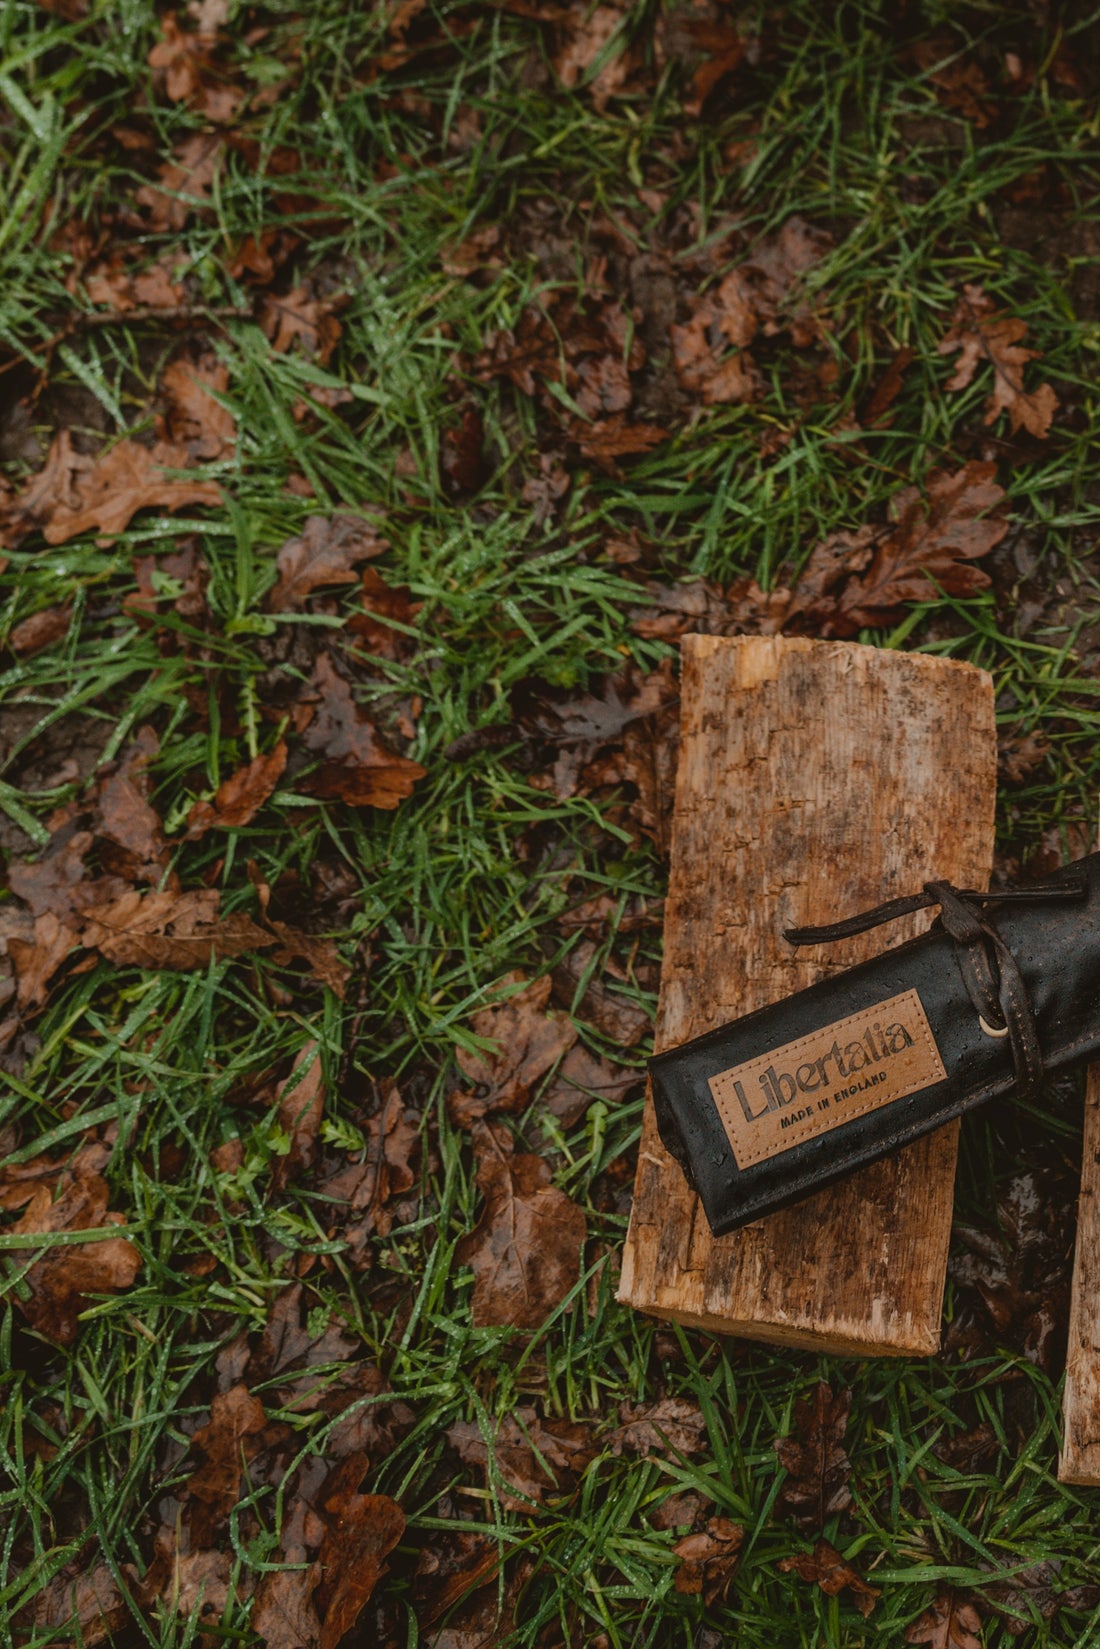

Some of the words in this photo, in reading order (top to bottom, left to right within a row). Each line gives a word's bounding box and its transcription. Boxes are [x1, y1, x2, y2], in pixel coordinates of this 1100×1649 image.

[733, 1023, 915, 1123] Libertalia
[780, 1107, 814, 1129] MADE
[818, 1096, 830, 1111] IN
[834, 1071, 887, 1103] ENGLAND
